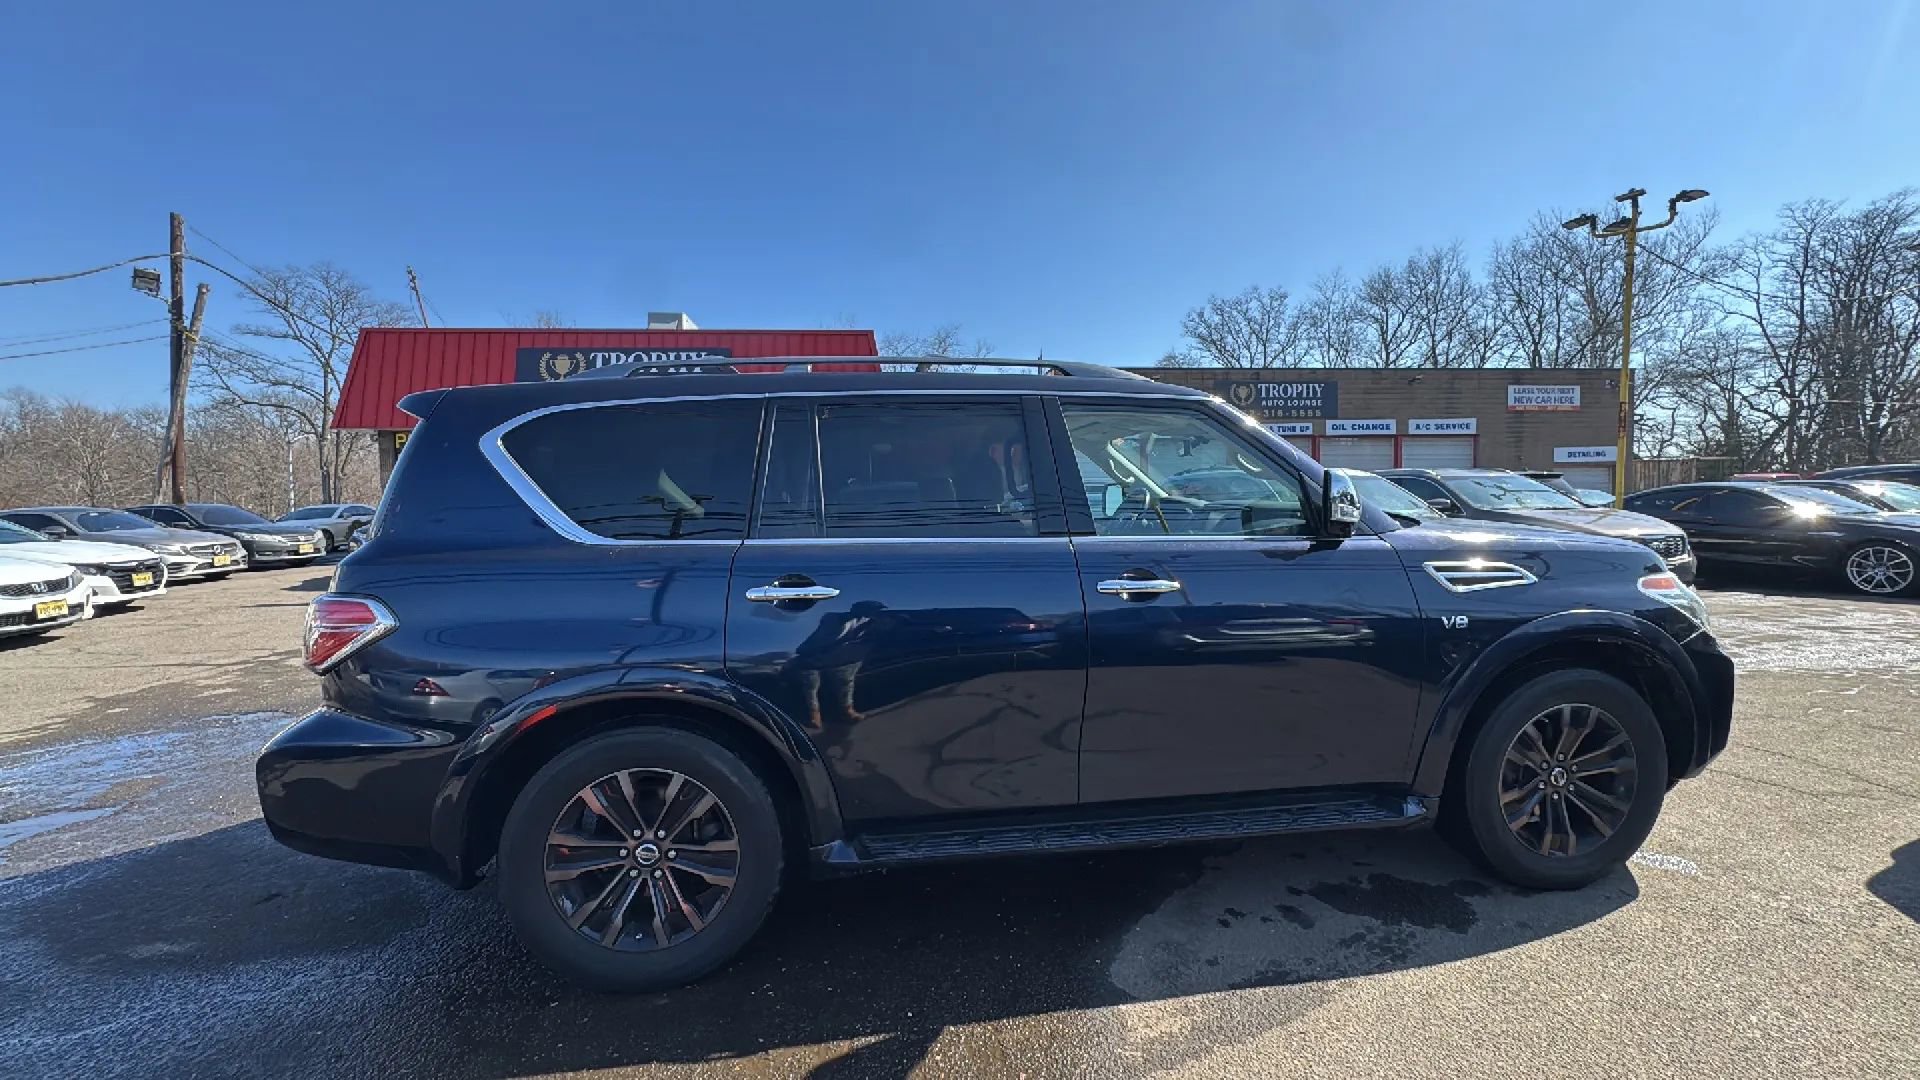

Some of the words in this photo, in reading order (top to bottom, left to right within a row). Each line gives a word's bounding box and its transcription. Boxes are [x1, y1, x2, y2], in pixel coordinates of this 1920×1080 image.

[1258, 383, 1324, 398] TROPHY
[1513, 396, 1534, 404] NEW
[1535, 396, 1553, 404] CAR
[1553, 396, 1575, 404] HERE
[1277, 425, 1297, 433] TUNE
[1299, 425, 1310, 433] UP
[1331, 423, 1347, 431] OIL
[1351, 423, 1392, 431] CHANGE
[1434, 422, 1471, 430] SERVICE
[1441, 615, 1469, 629] V8
